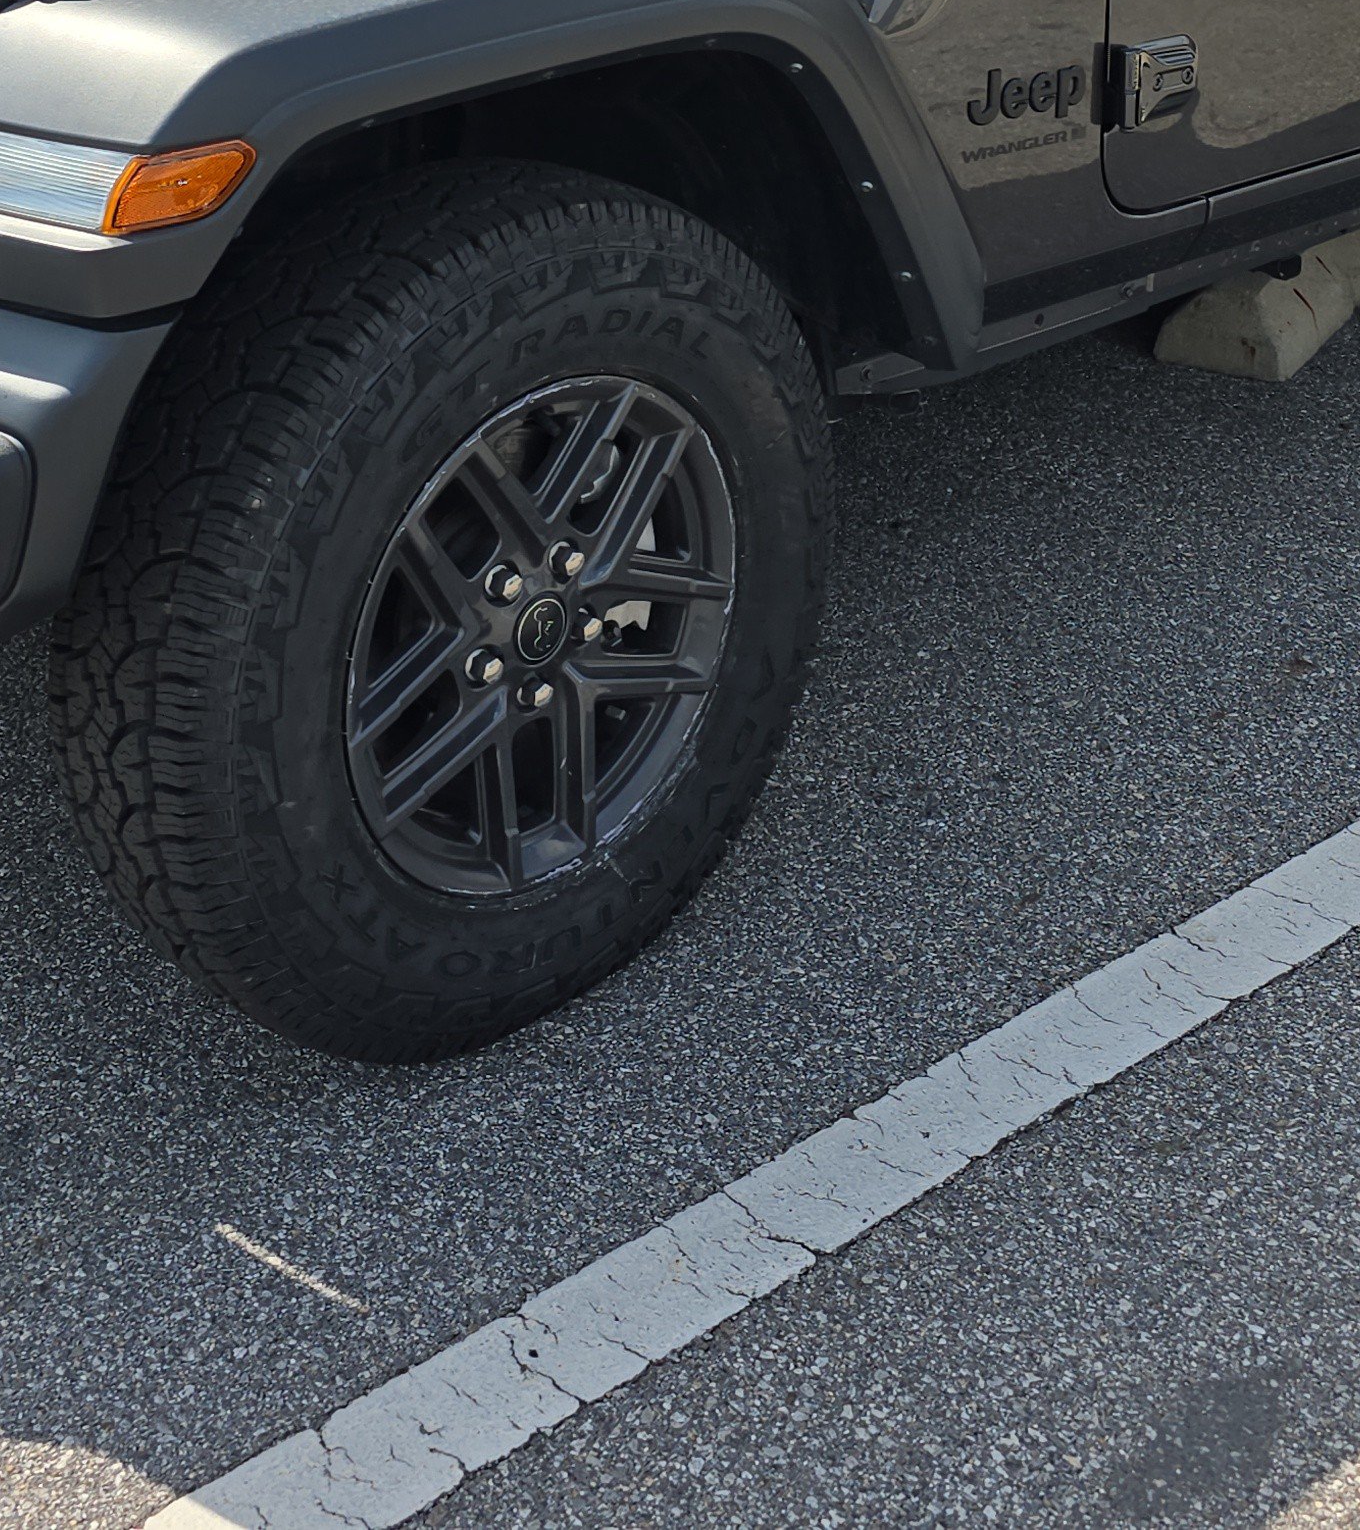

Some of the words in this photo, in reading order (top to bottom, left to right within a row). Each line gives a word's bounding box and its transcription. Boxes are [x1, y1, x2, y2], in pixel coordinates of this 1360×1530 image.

[966, 64, 1087, 127] Jeep
[959, 129, 1068, 164] WRANGLER
[506, 307, 713, 368] RADIAL
[315, 863, 424, 962] ATX
